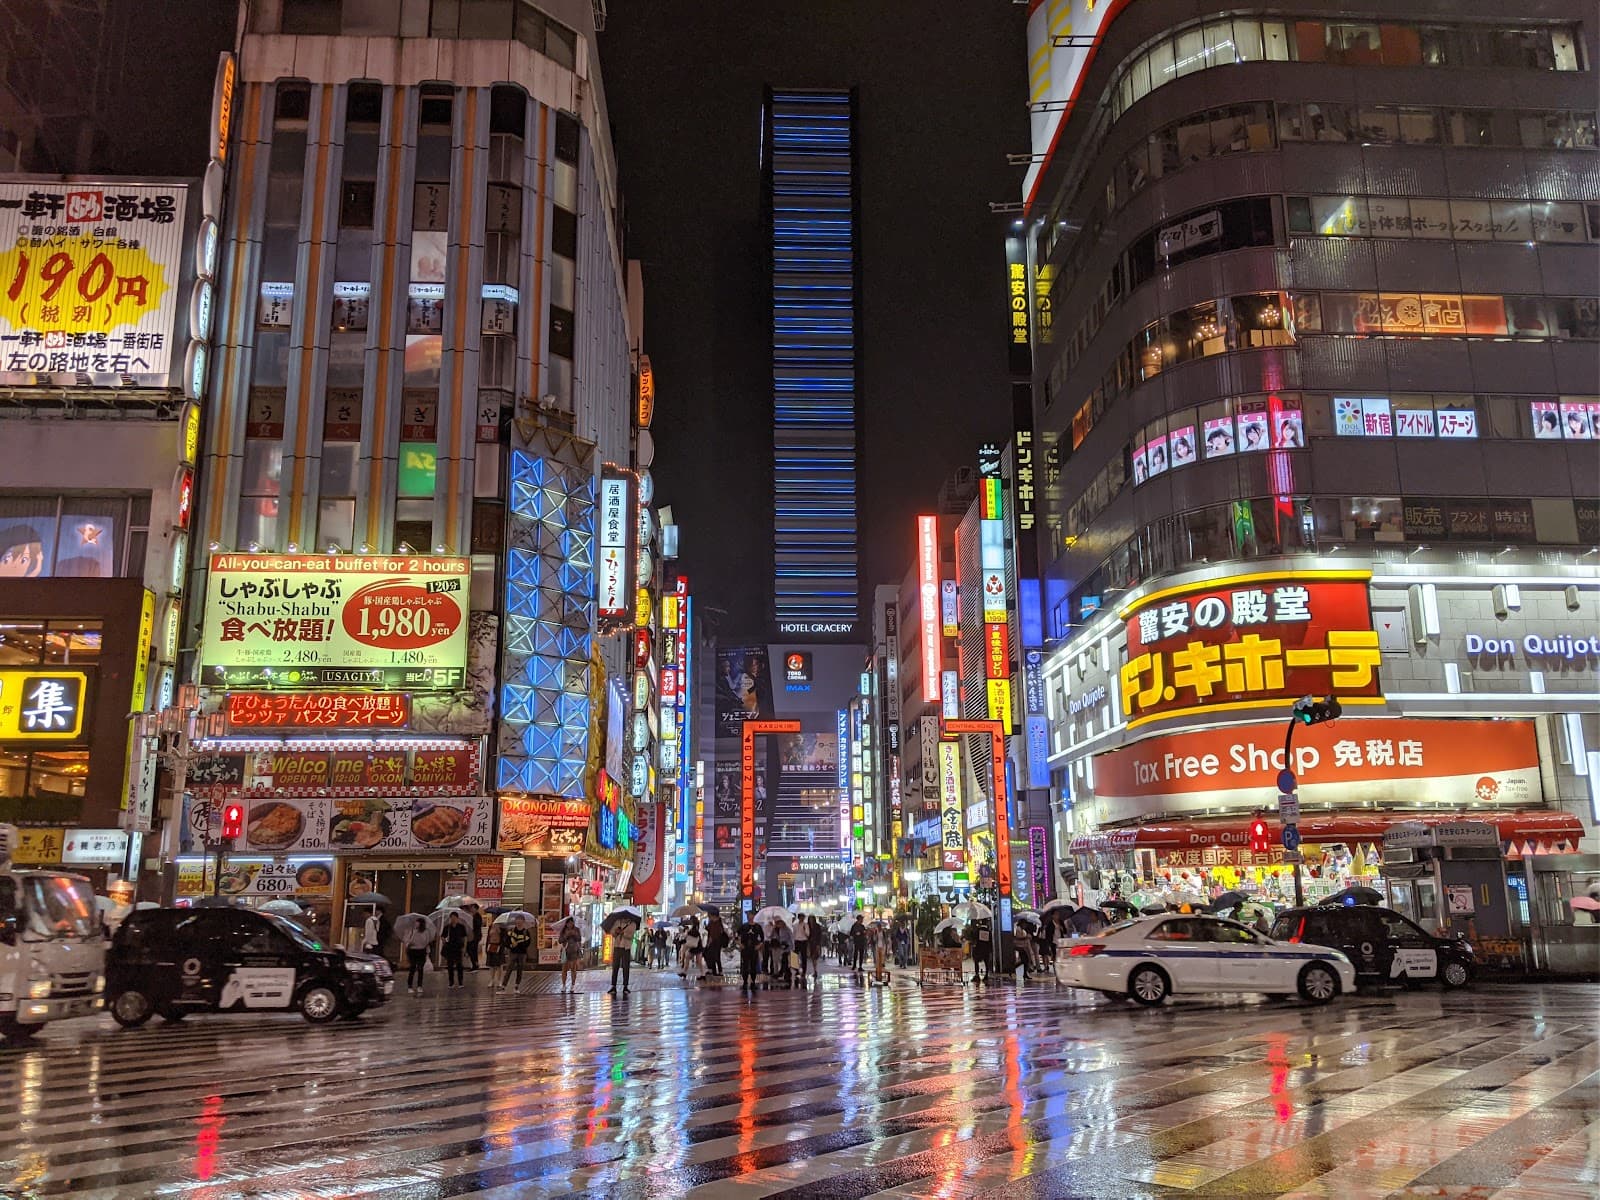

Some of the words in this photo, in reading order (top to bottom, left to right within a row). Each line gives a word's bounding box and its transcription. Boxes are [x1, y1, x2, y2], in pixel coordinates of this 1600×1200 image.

[7, 251, 150, 306] 190円
[1010, 263, 1027, 343] 驚安の殿堂
[7, 352, 150, 373] 左の路地を右へ
[1365, 413, 1392, 435] 新宿
[1398, 414, 1433, 434] アイドル
[1439, 415, 1475, 435] ステージ
[608, 484, 619, 543] 居酒屋食堂
[217, 558, 330, 572] All-you-can-eat
[334, 559, 378, 572] buffet
[382, 560, 404, 572] for
[408, 561, 419, 572] 2
[423, 561, 465, 572] hours
[220, 578, 342, 599] しゃぶしゃぶ
[357, 607, 431, 640] 1,980
[431, 626, 450, 637] yen
[1139, 586, 1311, 644] 驚安の殿堂
[780, 624, 810, 633] HOTEL
[811, 624, 852, 633] GRACERY
[1465, 634, 1515, 654] Don
[433, 670, 460, 686] 5F
[785, 685, 812, 693] IMAX
[1069, 700, 1082, 714] Don
[1082, 684, 1105, 708] Quijote
[23, 679, 73, 729] 集
[295, 710, 338, 724] パスタ
[346, 710, 403, 724] スイーツ
[1333, 739, 1424, 768] 免税店
[1133, 759, 1159, 786] Tax
[1164, 752, 1220, 780] Free
[1229, 743, 1320, 776] Shop
[279, 773, 309, 784] OPEN
[312, 774, 326, 784] PM
[743, 745, 752, 823] GODZILLA
[504, 801, 561, 813] OKONOMI
[565, 802, 591, 814] YAKI
[1189, 833, 1216, 844] Don
[742, 832, 752, 870] ROAD
[944, 852, 957, 863] 2F
[1170, 850, 1232, 866] 欢度国庆
[256, 878, 294, 892] 680円
[1016, 859, 1029, 901] カラオケ
